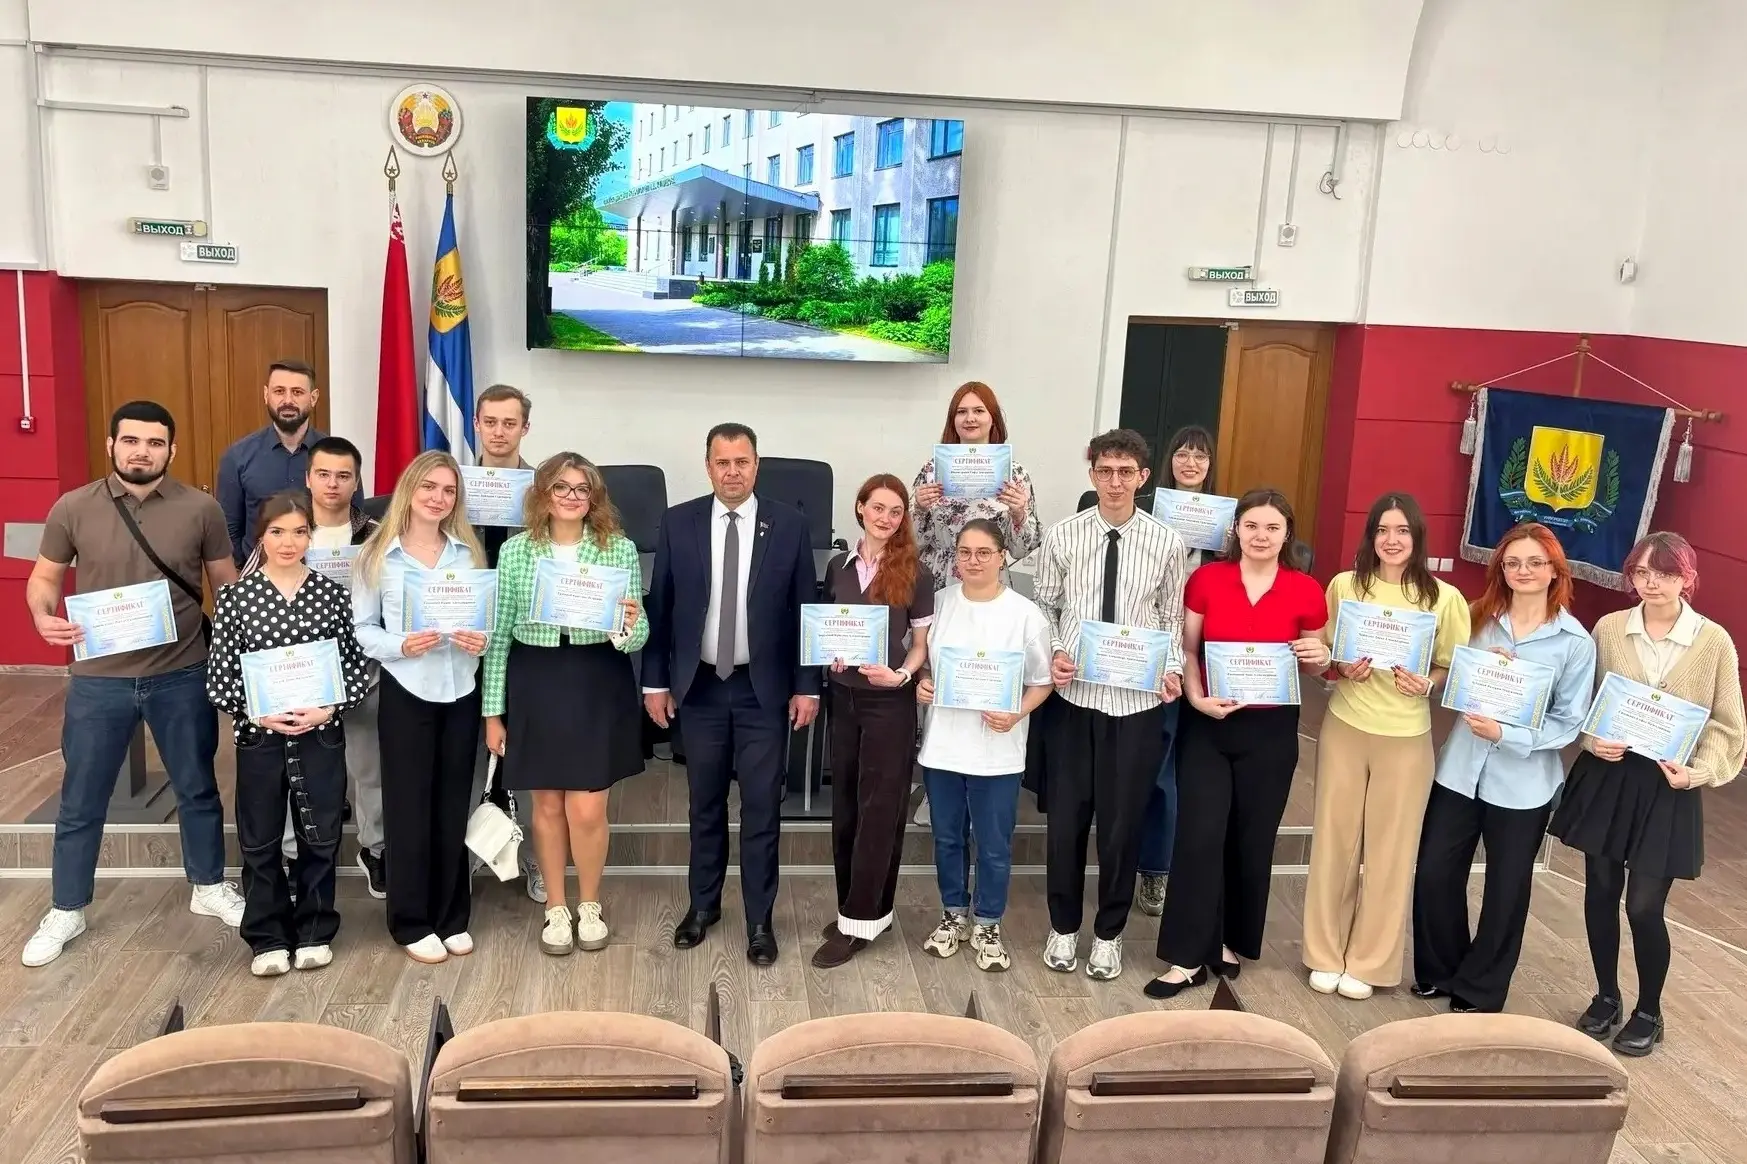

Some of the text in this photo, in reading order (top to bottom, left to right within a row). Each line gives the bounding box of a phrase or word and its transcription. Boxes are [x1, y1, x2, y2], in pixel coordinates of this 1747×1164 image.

[143, 225, 184, 235] ВЫХОД
[199, 247, 234, 259] ВЫХОД
[1209, 271, 1244, 280] ВЫХОД
[1245, 292, 1276, 303] ВЫХОД
[470, 480, 511, 489] СЕРТИФИКАТ
[1175, 504, 1213, 515] СЕРТИФИКАТ
[315, 561, 351, 569] СЕРТИФИК
[561, 577, 603, 589] СЕРТИФИКАТ
[97, 600, 145, 615] СЕРТИФИКАТ
[1363, 619, 1409, 633] СЕРТИФИКАТ
[1102, 639, 1144, 652] СЕРТИФИКАТ
[269, 660, 314, 673] СЕРТИФИКАТ
[960, 662, 1000, 672] СЕРТИФИКАТ
[1477, 667, 1524, 684] СЕРТИФИКАТ
[1626, 698, 1675, 721] СЕРТИФИКАТ
